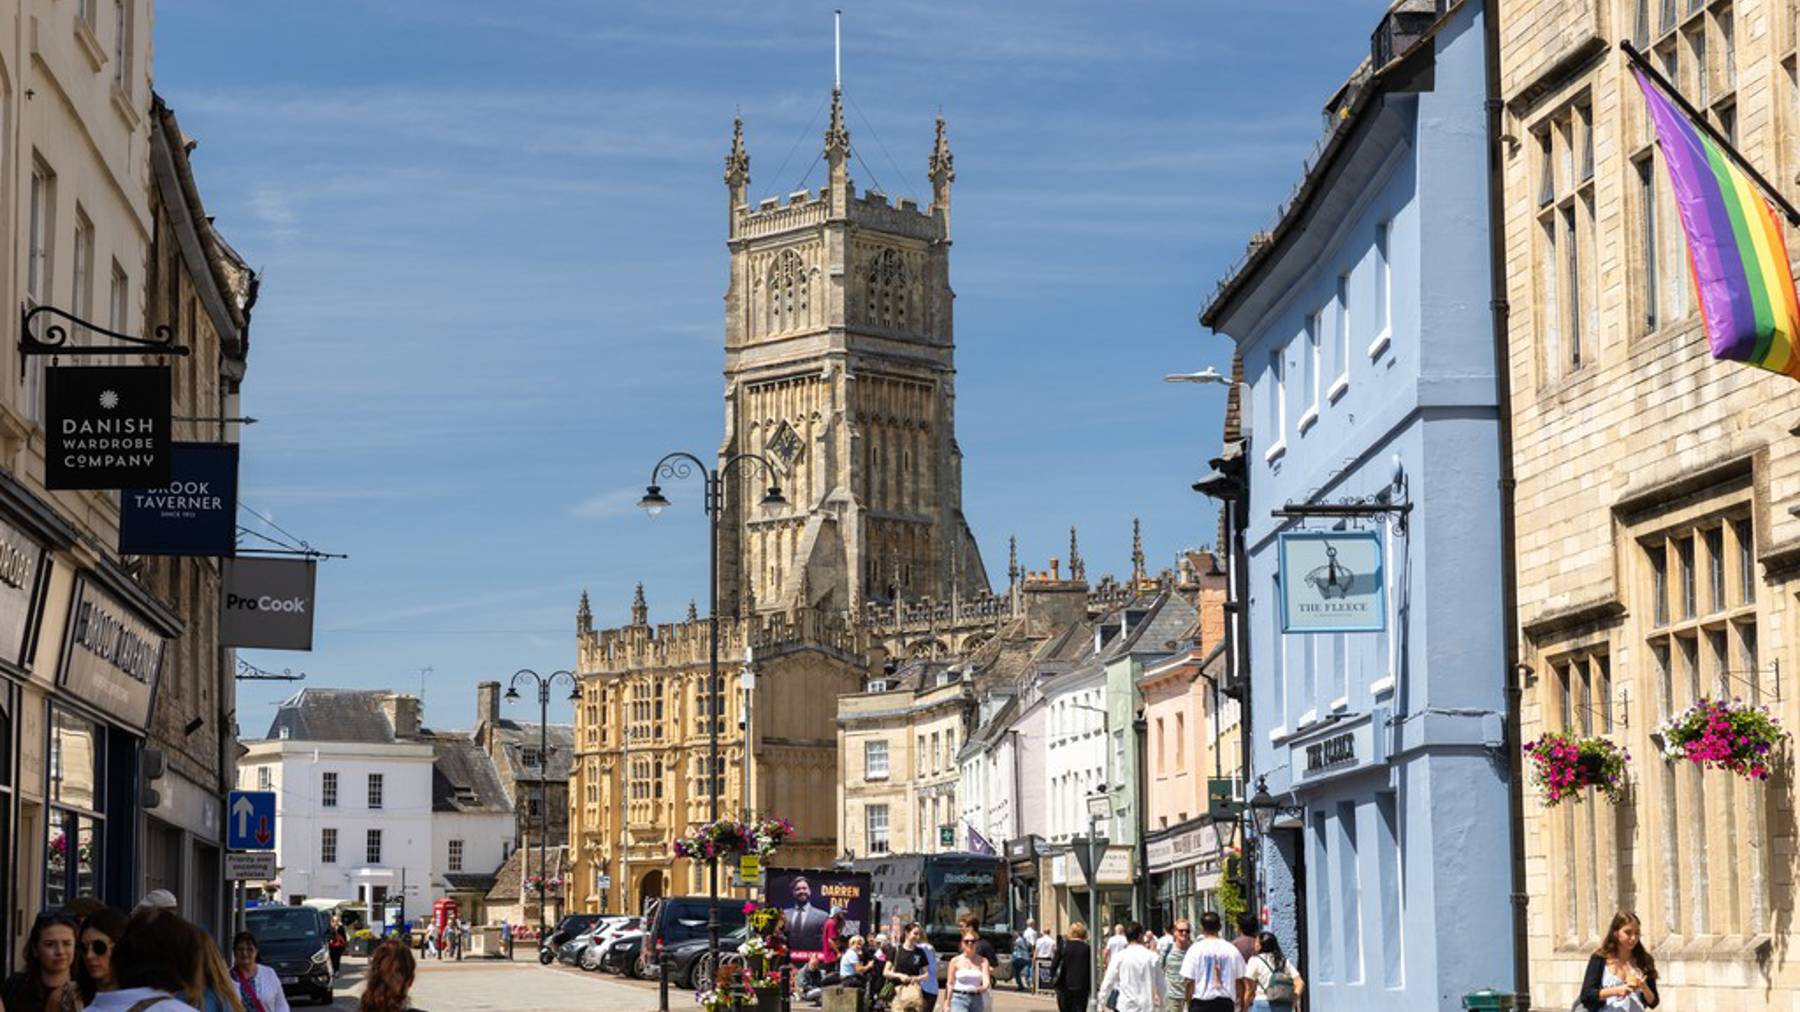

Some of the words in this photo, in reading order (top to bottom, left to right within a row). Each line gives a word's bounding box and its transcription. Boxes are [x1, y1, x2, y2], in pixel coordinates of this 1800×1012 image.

[62, 418, 153, 434] DANISH
[62, 438, 153, 450] WARDROBE
[64, 454, 154, 468] COMPANY
[134, 495, 223, 511] TAVERNER
[225, 593, 305, 613] ProCook
[1297, 603, 1322, 612] THE
[1324, 602, 1369, 612] FLEECE
[820, 884, 860, 897] DARREN
[829, 896, 850, 909] DAY
